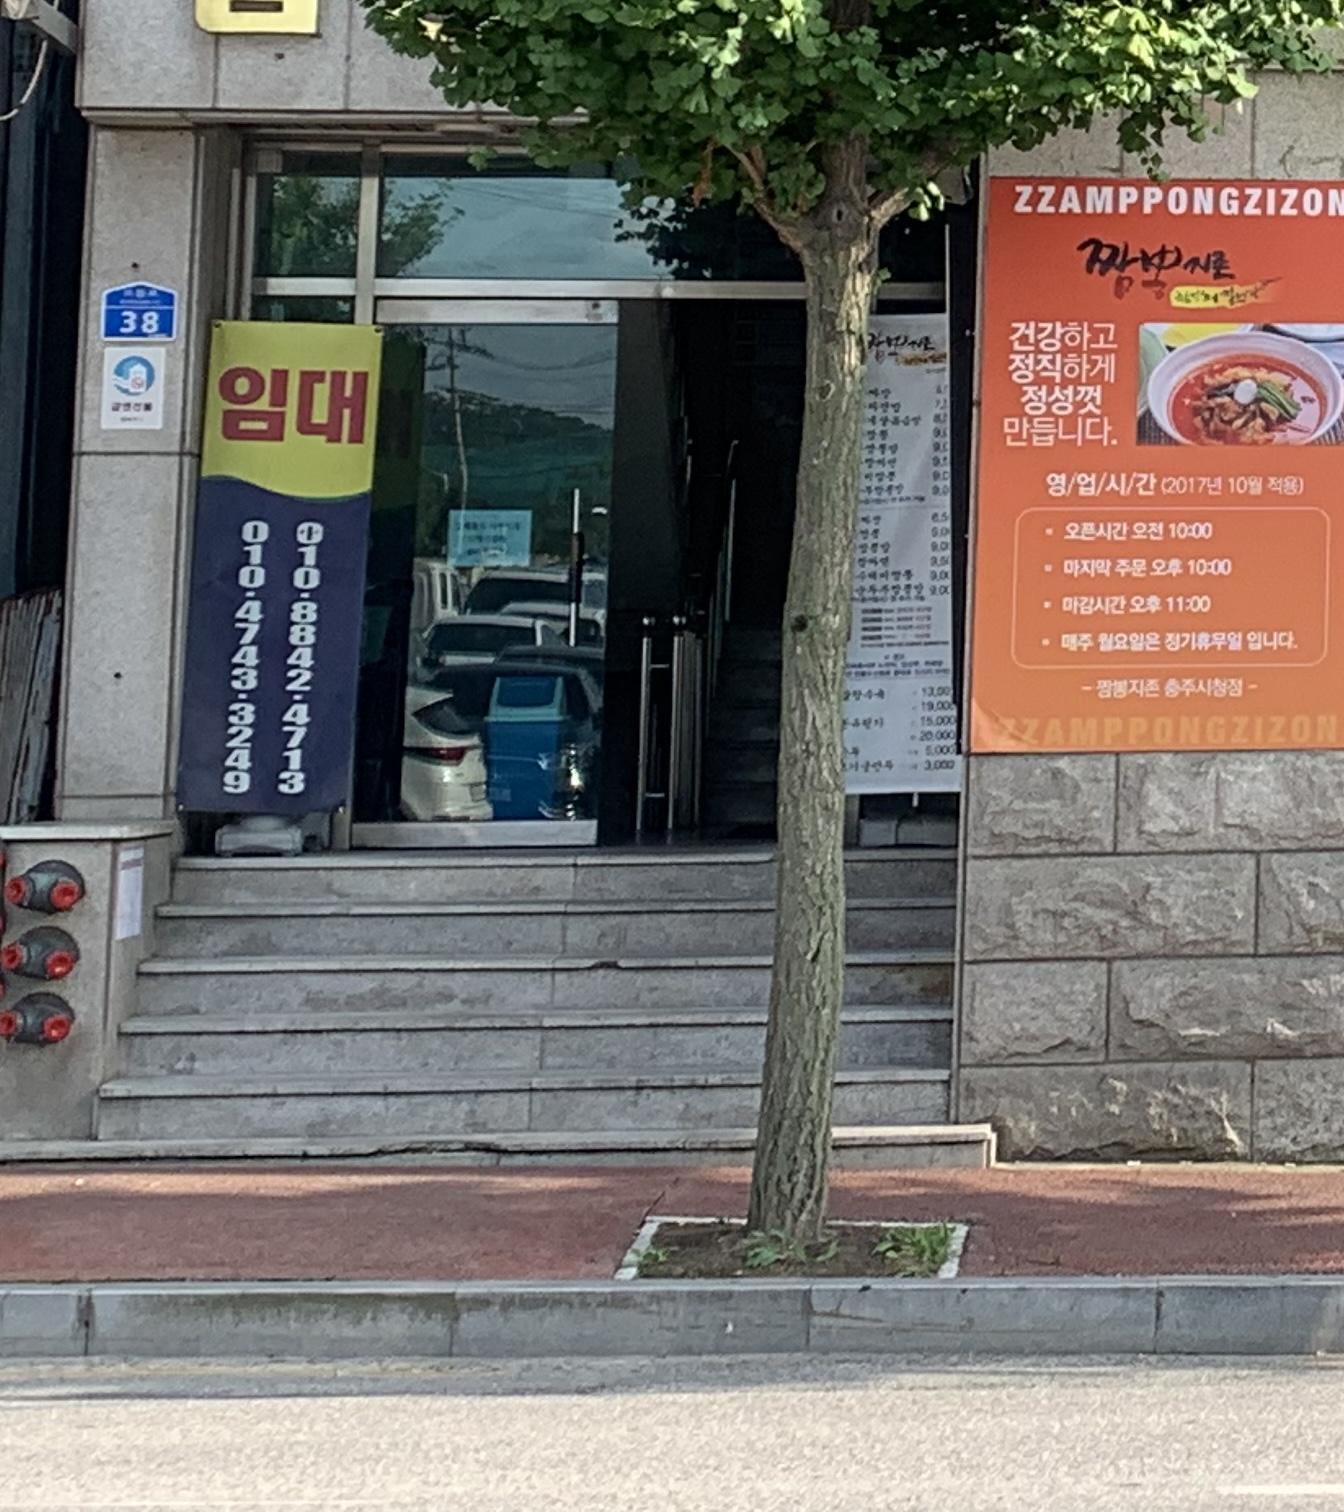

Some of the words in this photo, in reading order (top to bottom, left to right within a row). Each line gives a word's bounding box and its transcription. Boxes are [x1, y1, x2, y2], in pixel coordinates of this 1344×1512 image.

[118, 310, 160, 335] 38
[1008, 321, 1119, 352] 건강하고
[1007, 353, 1117, 384] 정직하게
[217, 365, 370, 445] 임대
[1020, 384, 1103, 414] 정성껏
[1003, 416, 1118, 447] 만듭니다.
[1045, 472, 1157, 497] 영/업/시/간
[1160, 476, 1222, 495] (2017년
[1228, 476, 1262, 495] 10월
[1266, 476, 1304, 495] 적용)
[1063, 522, 1127, 540] 오픈시간
[1131, 522, 1164, 540] 오전
[1168, 522, 1213, 539] 10:00
[1063, 559, 1110, 578] 마지막
[1114, 559, 1147, 577] 주문
[1150, 559, 1183, 577] 오후
[1187, 558, 1232, 576] 10:00
[1061, 596, 1125, 615] 마감시간
[1128, 596, 1161, 614] 오후
[1166, 595, 1211, 613] 11:00
[1060, 633, 1094, 652] 매주
[1098, 633, 1161, 651] 월요일은
[1164, 632, 1242, 651] 정기휴무일
[1247, 632, 1298, 651] 입니다.
